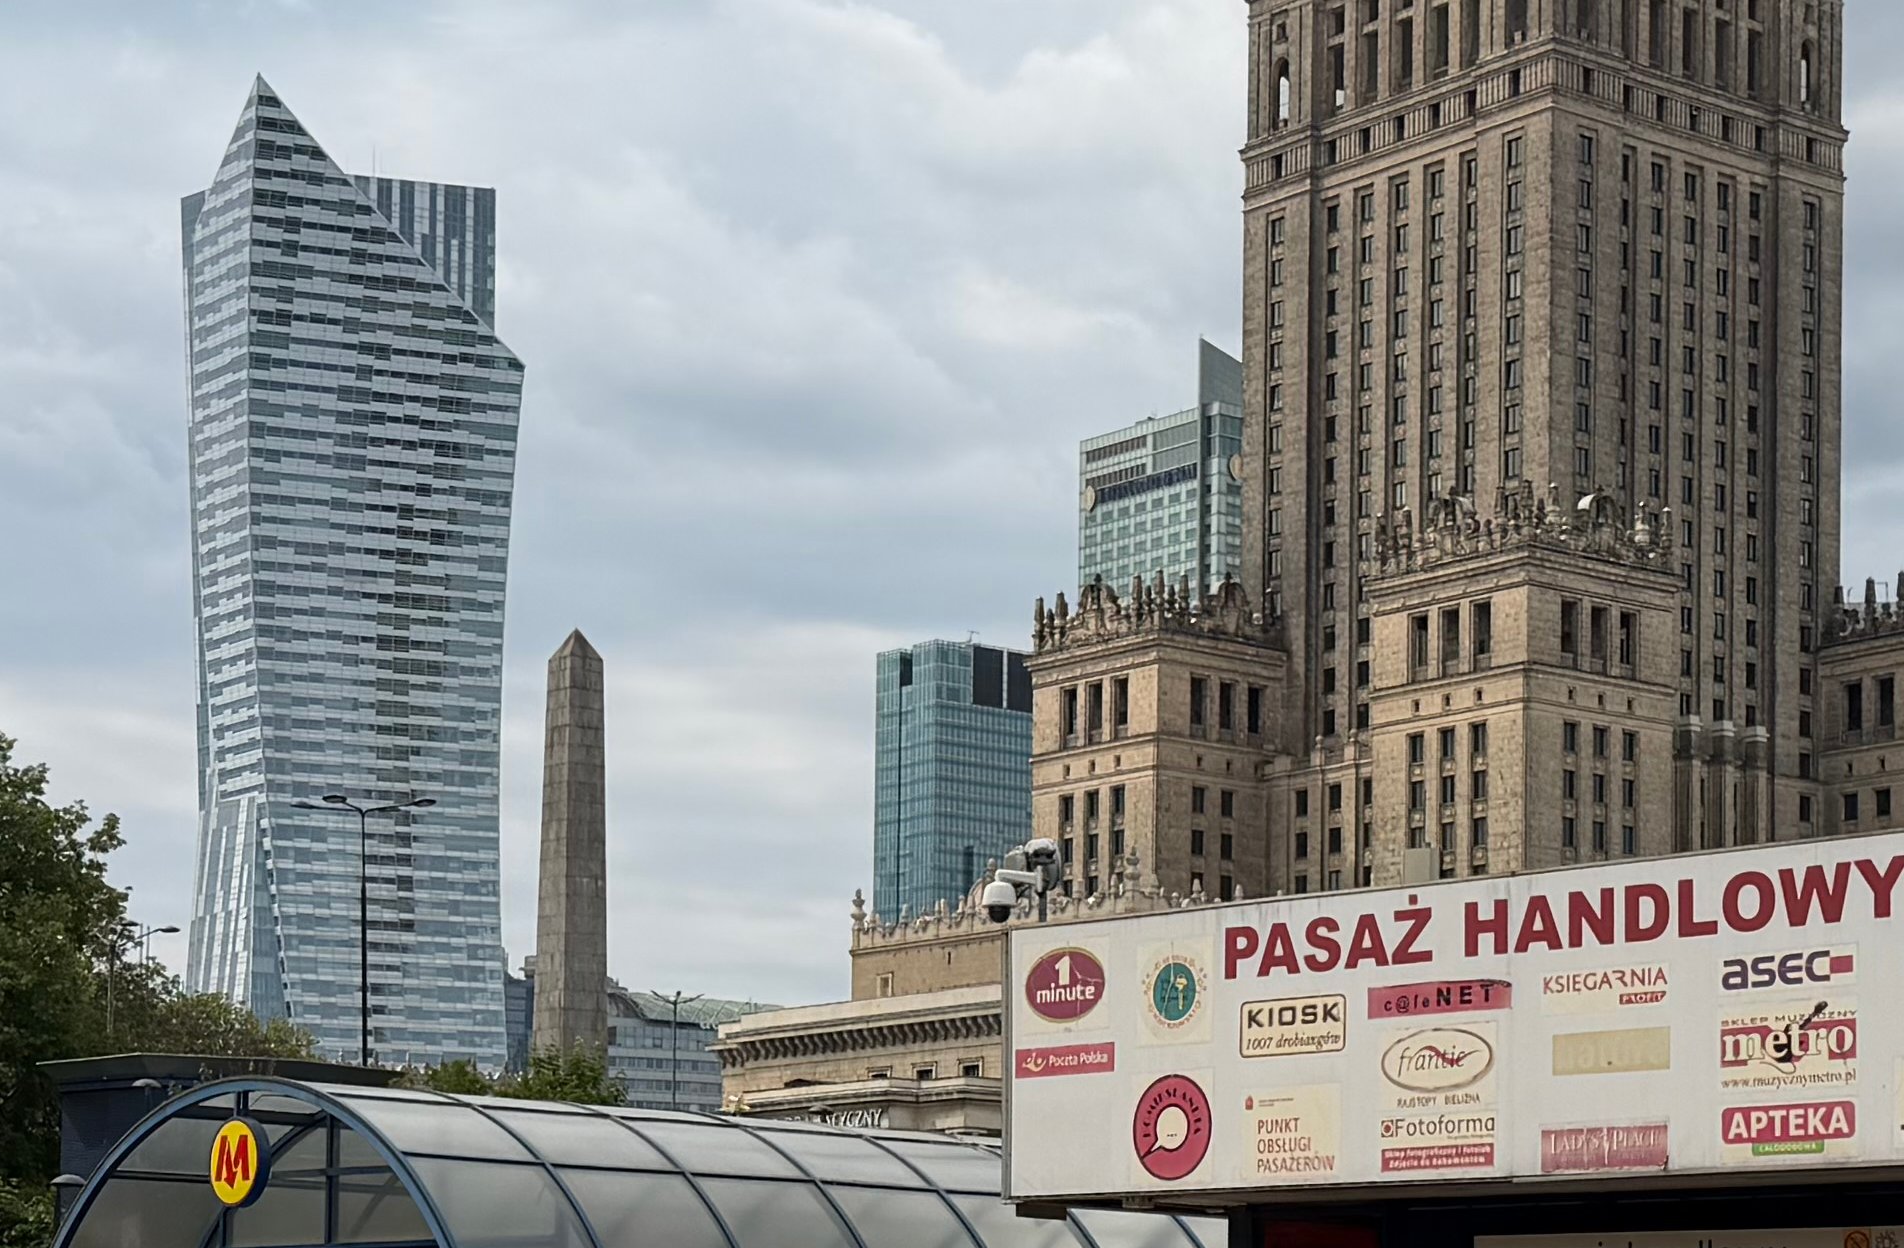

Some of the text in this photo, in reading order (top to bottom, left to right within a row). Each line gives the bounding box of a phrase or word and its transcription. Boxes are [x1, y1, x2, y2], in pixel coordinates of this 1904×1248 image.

[1224, 893, 1433, 980] PASAŻ
[1055, 955, 1071, 985] 1
[1543, 967, 1668, 995] KSIĘGARNIA
[1036, 983, 1096, 1004] minute
[1247, 1002, 1341, 1029] KIOSK
[1721, 1016, 1769, 1026] SKLEP
[1246, 1036, 1274, 1050] 1007
[1722, 1023, 1854, 1062] metro
[1049, 1051, 1109, 1067] Poczta Polska
[1397, 1045, 1466, 1078] frantic
[1257, 1118, 1300, 1134] PUNKT
[1395, 1114, 1496, 1138] Fotoforma
[1727, 1106, 1850, 1140] APTEKA
[1257, 1137, 1312, 1154] OBSŁUGI
[1257, 1150, 1336, 1173] PASAŻERÓW
